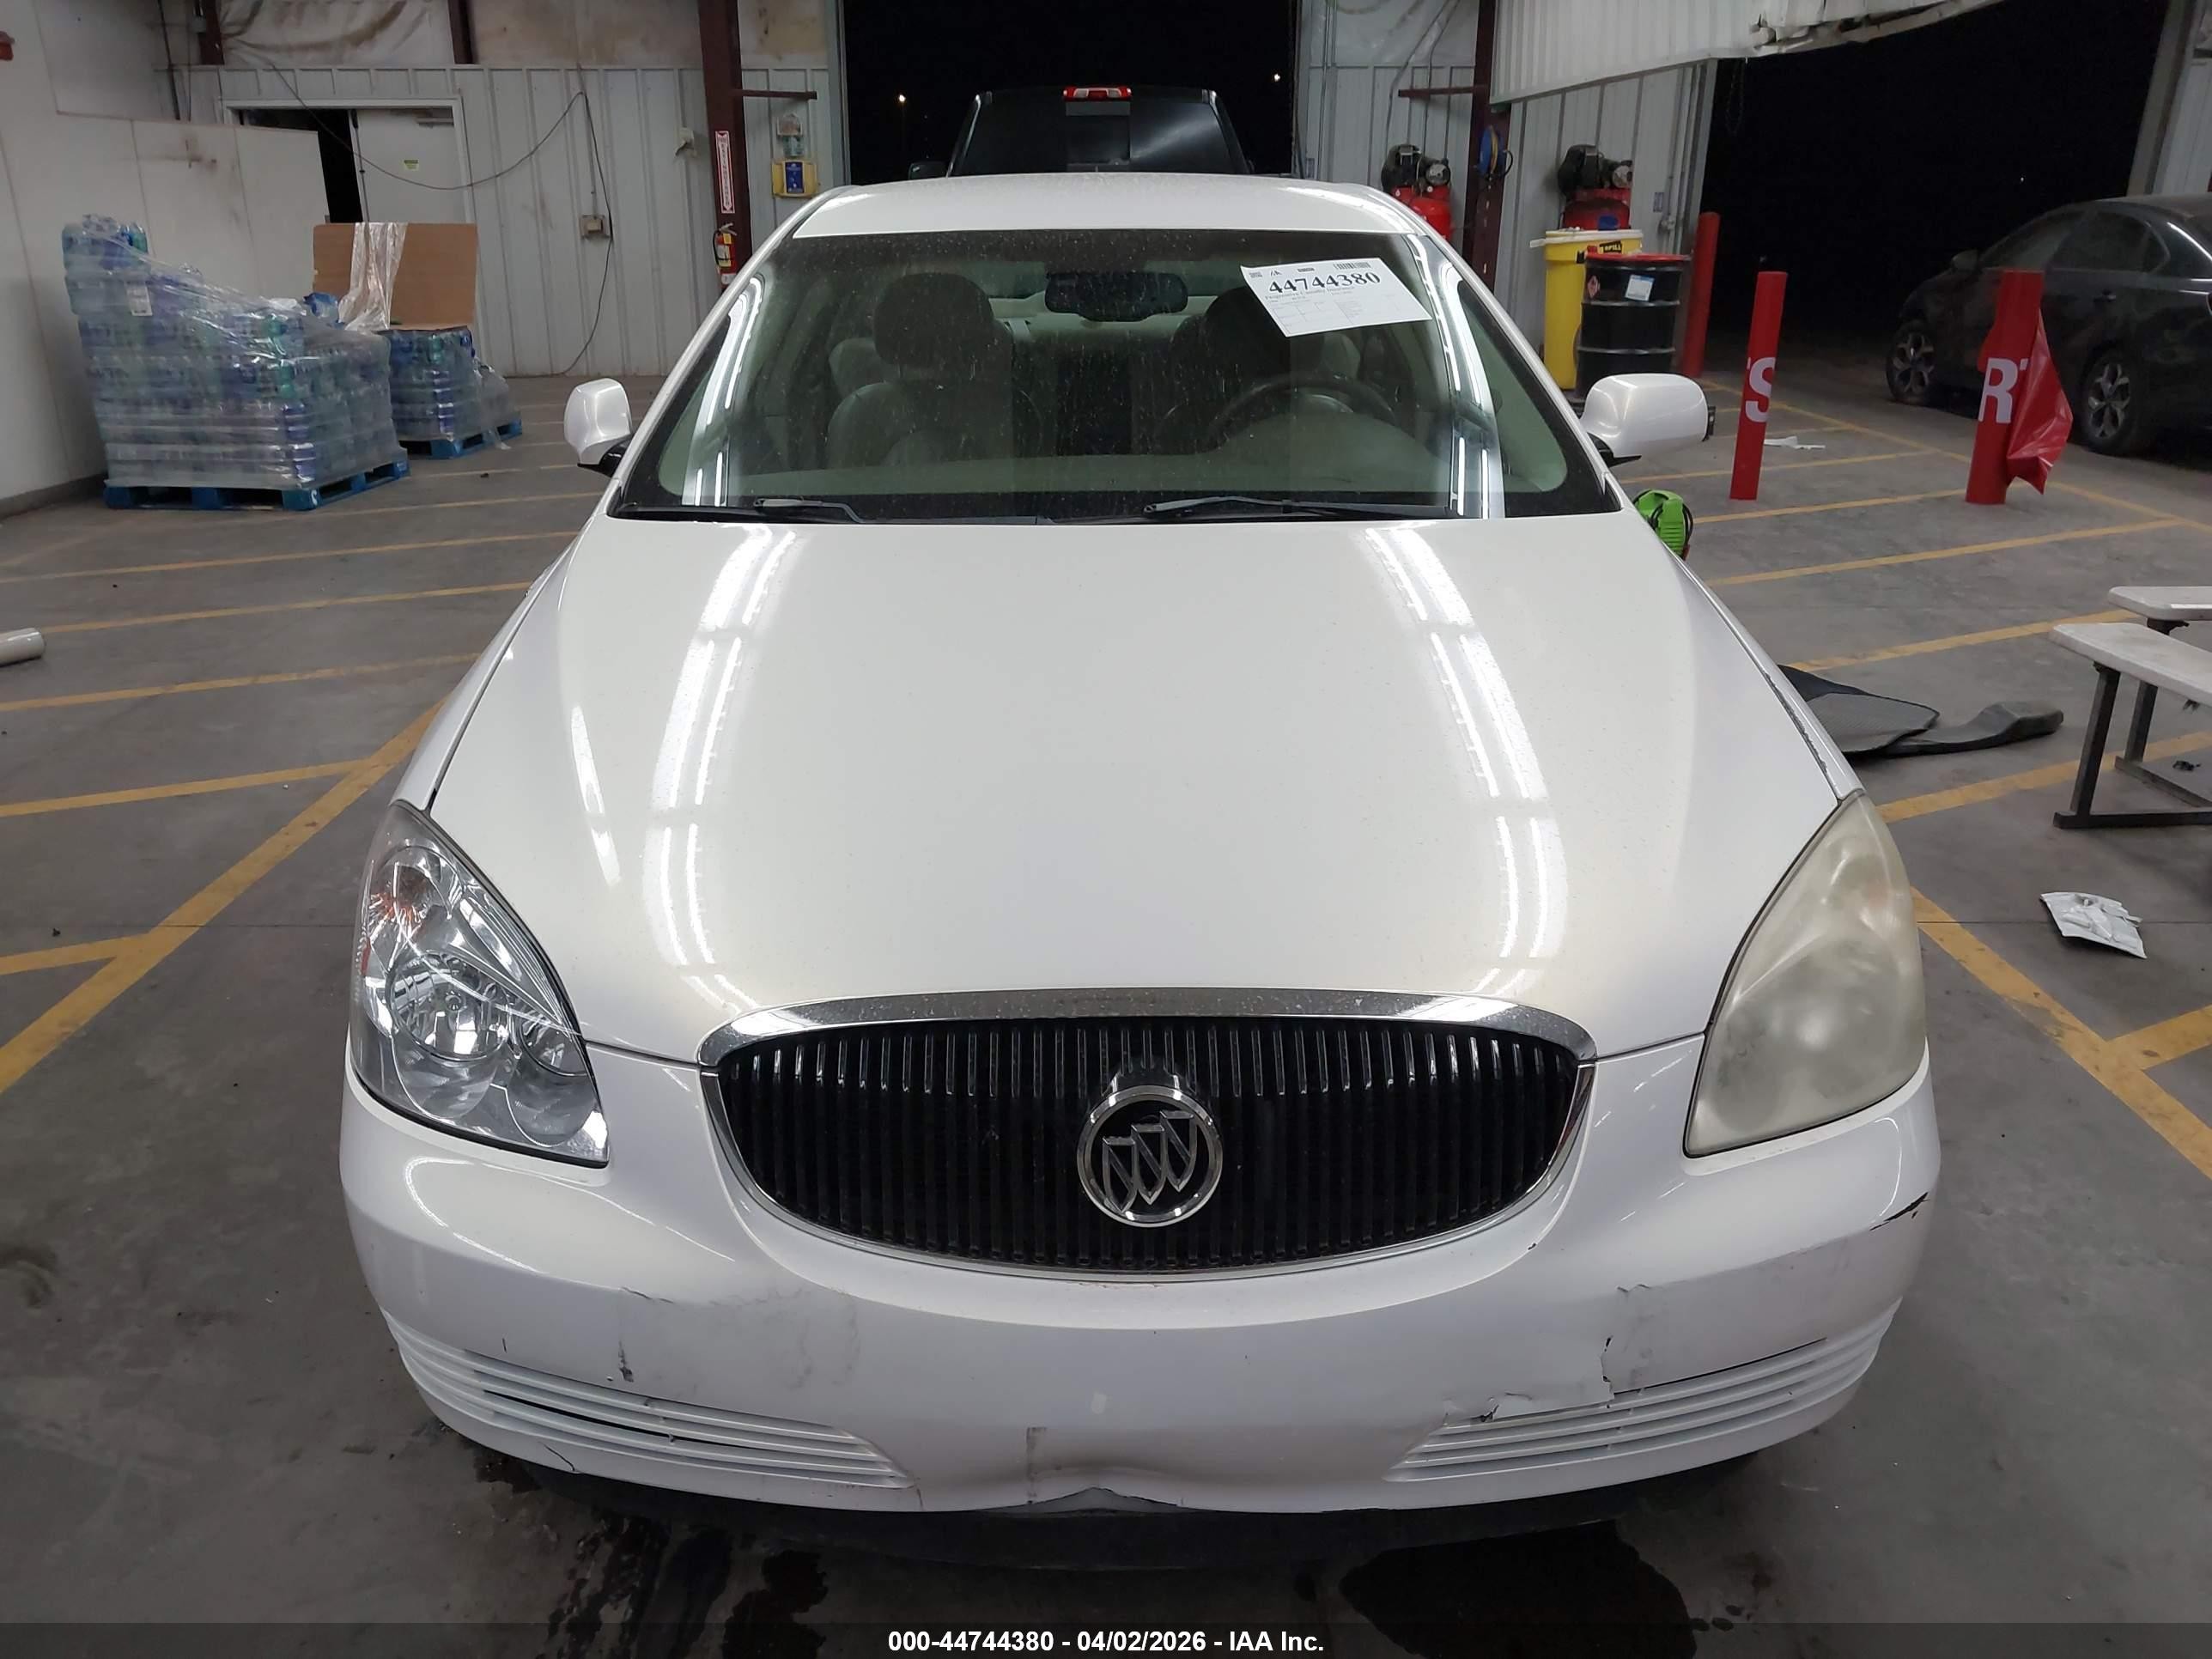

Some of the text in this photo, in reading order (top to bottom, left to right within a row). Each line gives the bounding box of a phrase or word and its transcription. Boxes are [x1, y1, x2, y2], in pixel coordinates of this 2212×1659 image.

[1269, 272, 1381, 293] 44744380
[1746, 356, 1776, 423] S
[1978, 357, 2029, 424] R
